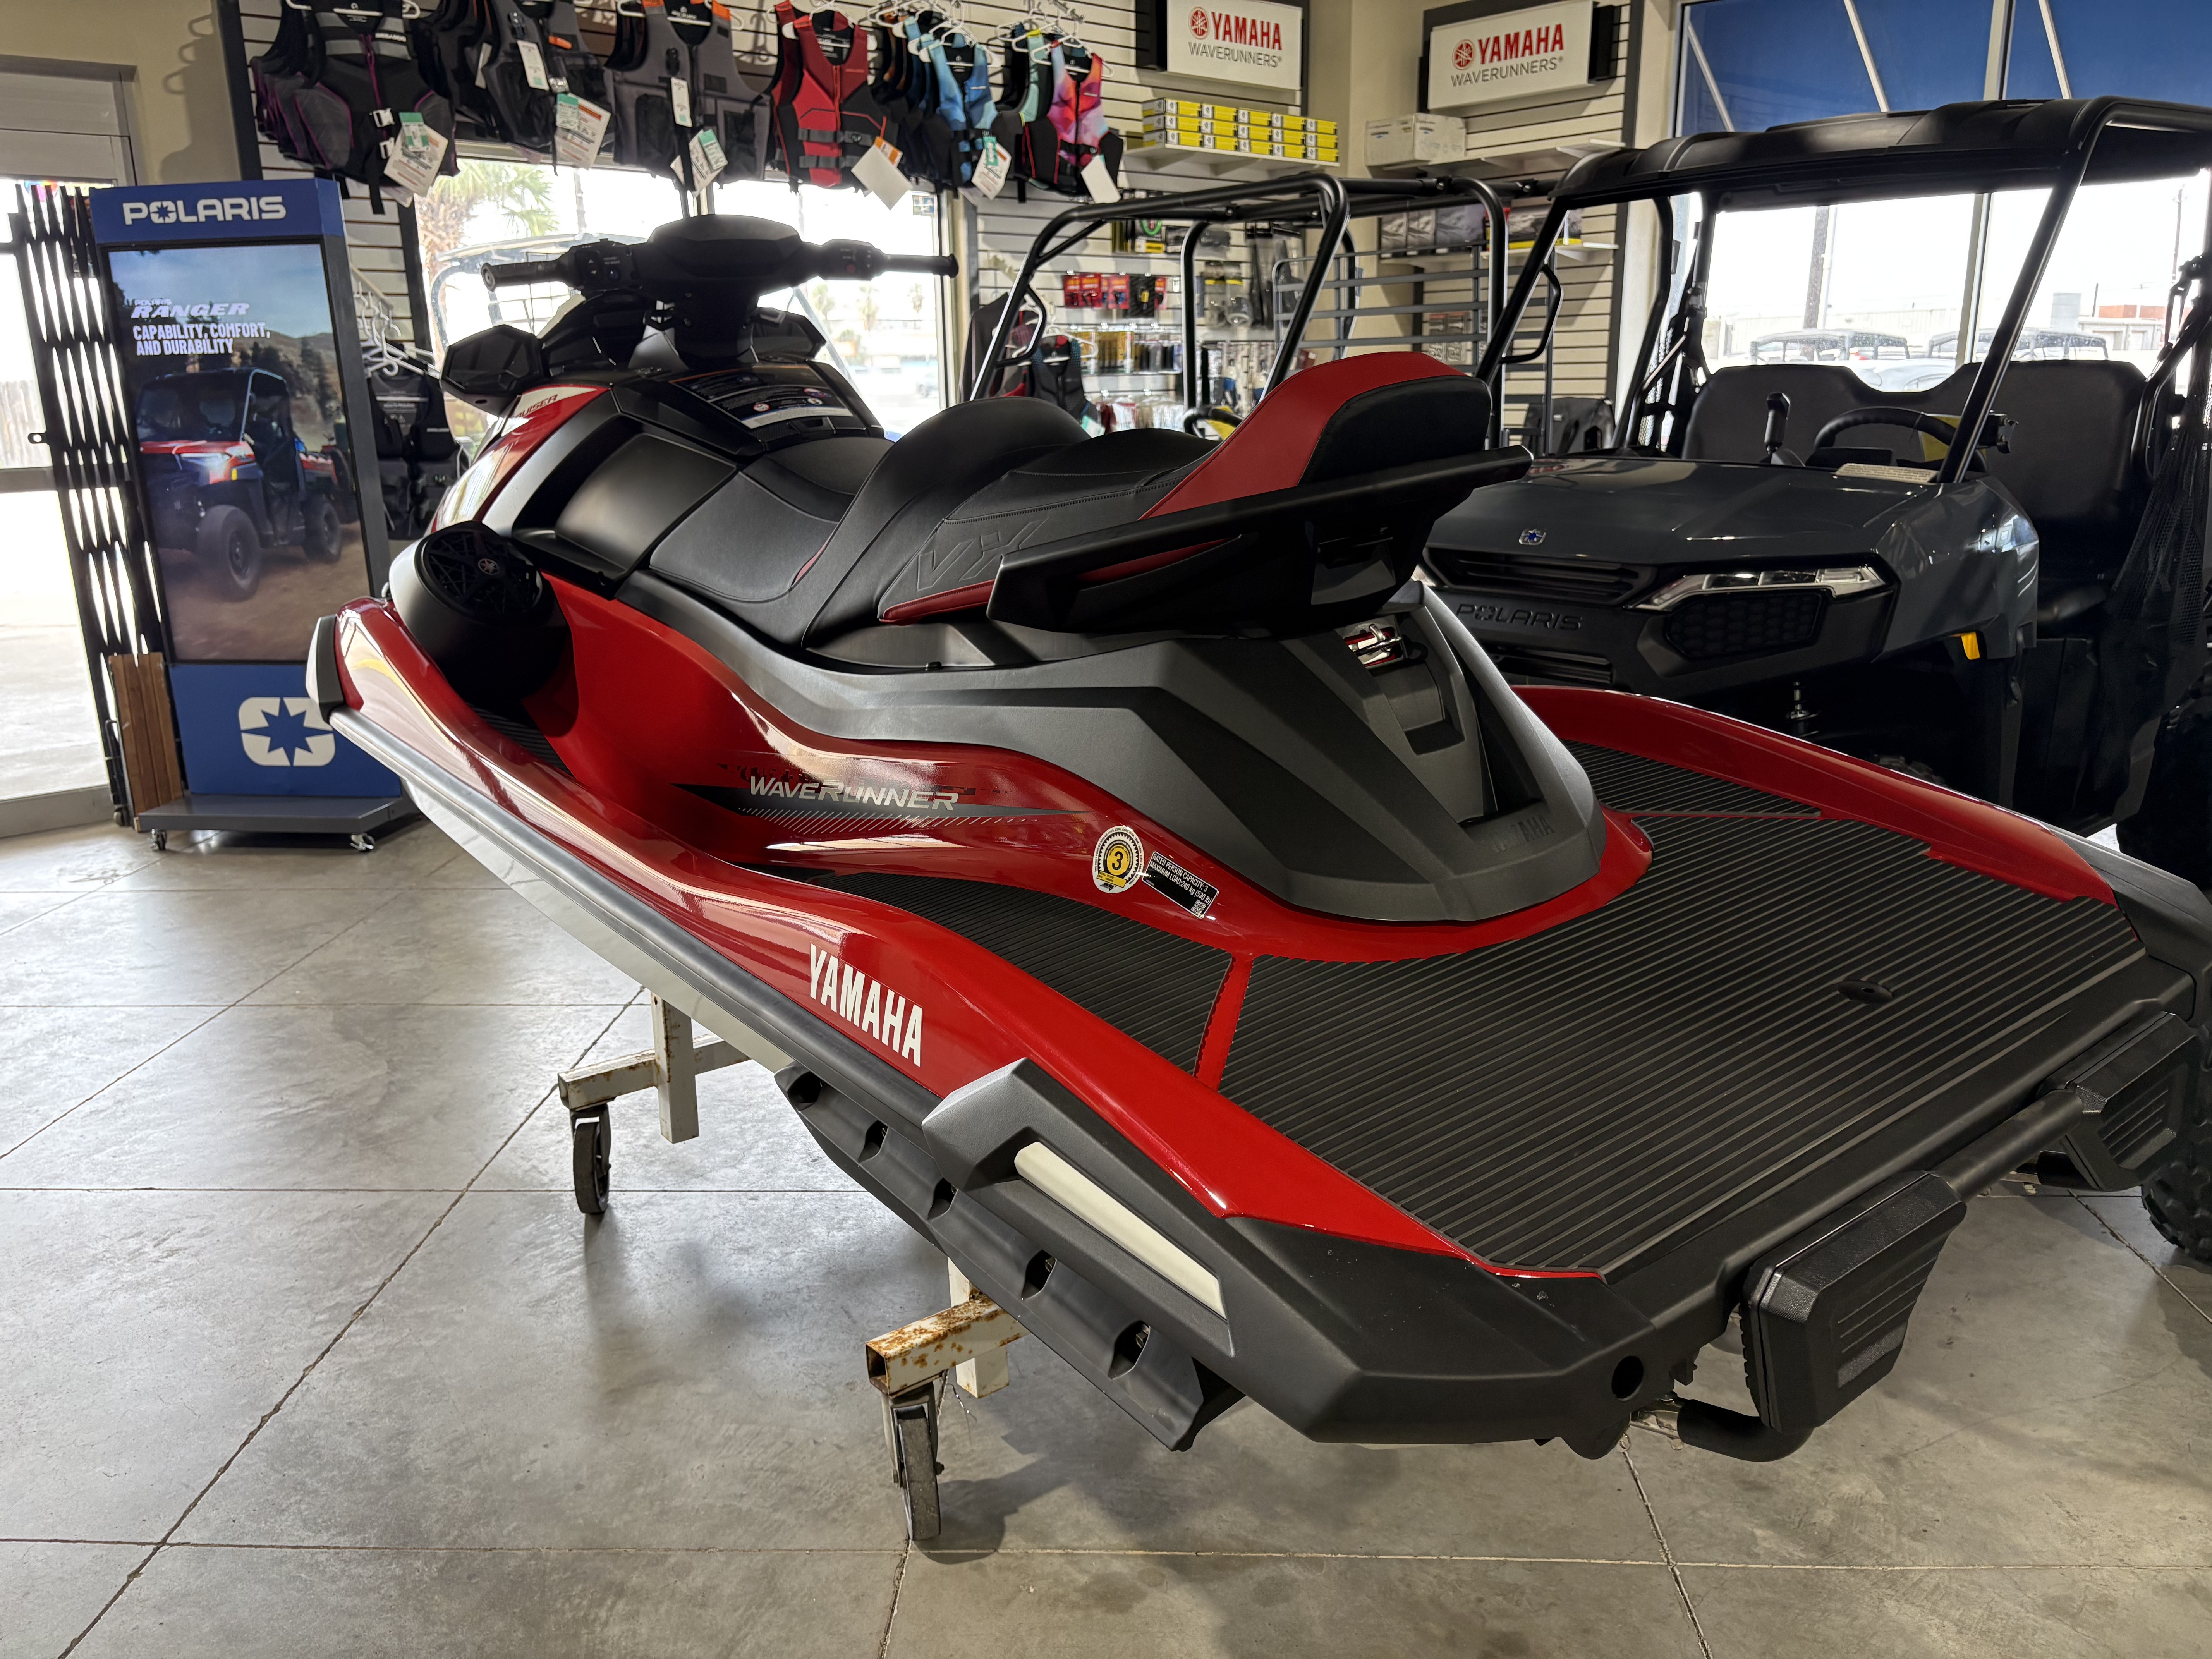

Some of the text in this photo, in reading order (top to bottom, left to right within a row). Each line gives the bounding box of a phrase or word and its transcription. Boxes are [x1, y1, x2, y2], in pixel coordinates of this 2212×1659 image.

[1211, 12, 1282, 50] YAMAHA
[1477, 23, 1564, 65] YAMAHA
[123, 196, 286, 225] POLARIS
[131, 303, 249, 318] RANGER
[133, 322, 270, 340] CAPABILITY, COMFORT,
[137, 338, 233, 356] AND DURABILITY
[516, 394, 558, 417] RUISER
[917, 517, 1049, 591] VX
[1456, 603, 1583, 631] POLARIS
[750, 776, 959, 811] WAVERUNNER
[1112, 851, 1123, 870] 3
[1152, 853, 1166, 866] RATED
[1166, 862, 1183, 877] PERSON
[1183, 872, 1204, 890] CAPACITY:
[1149, 860, 1170, 878] MAXIMUM
[1188, 886, 1195, 895] kg
[1194, 889, 1205, 900] (530
[810, 943, 922, 1067] YAMAHA
